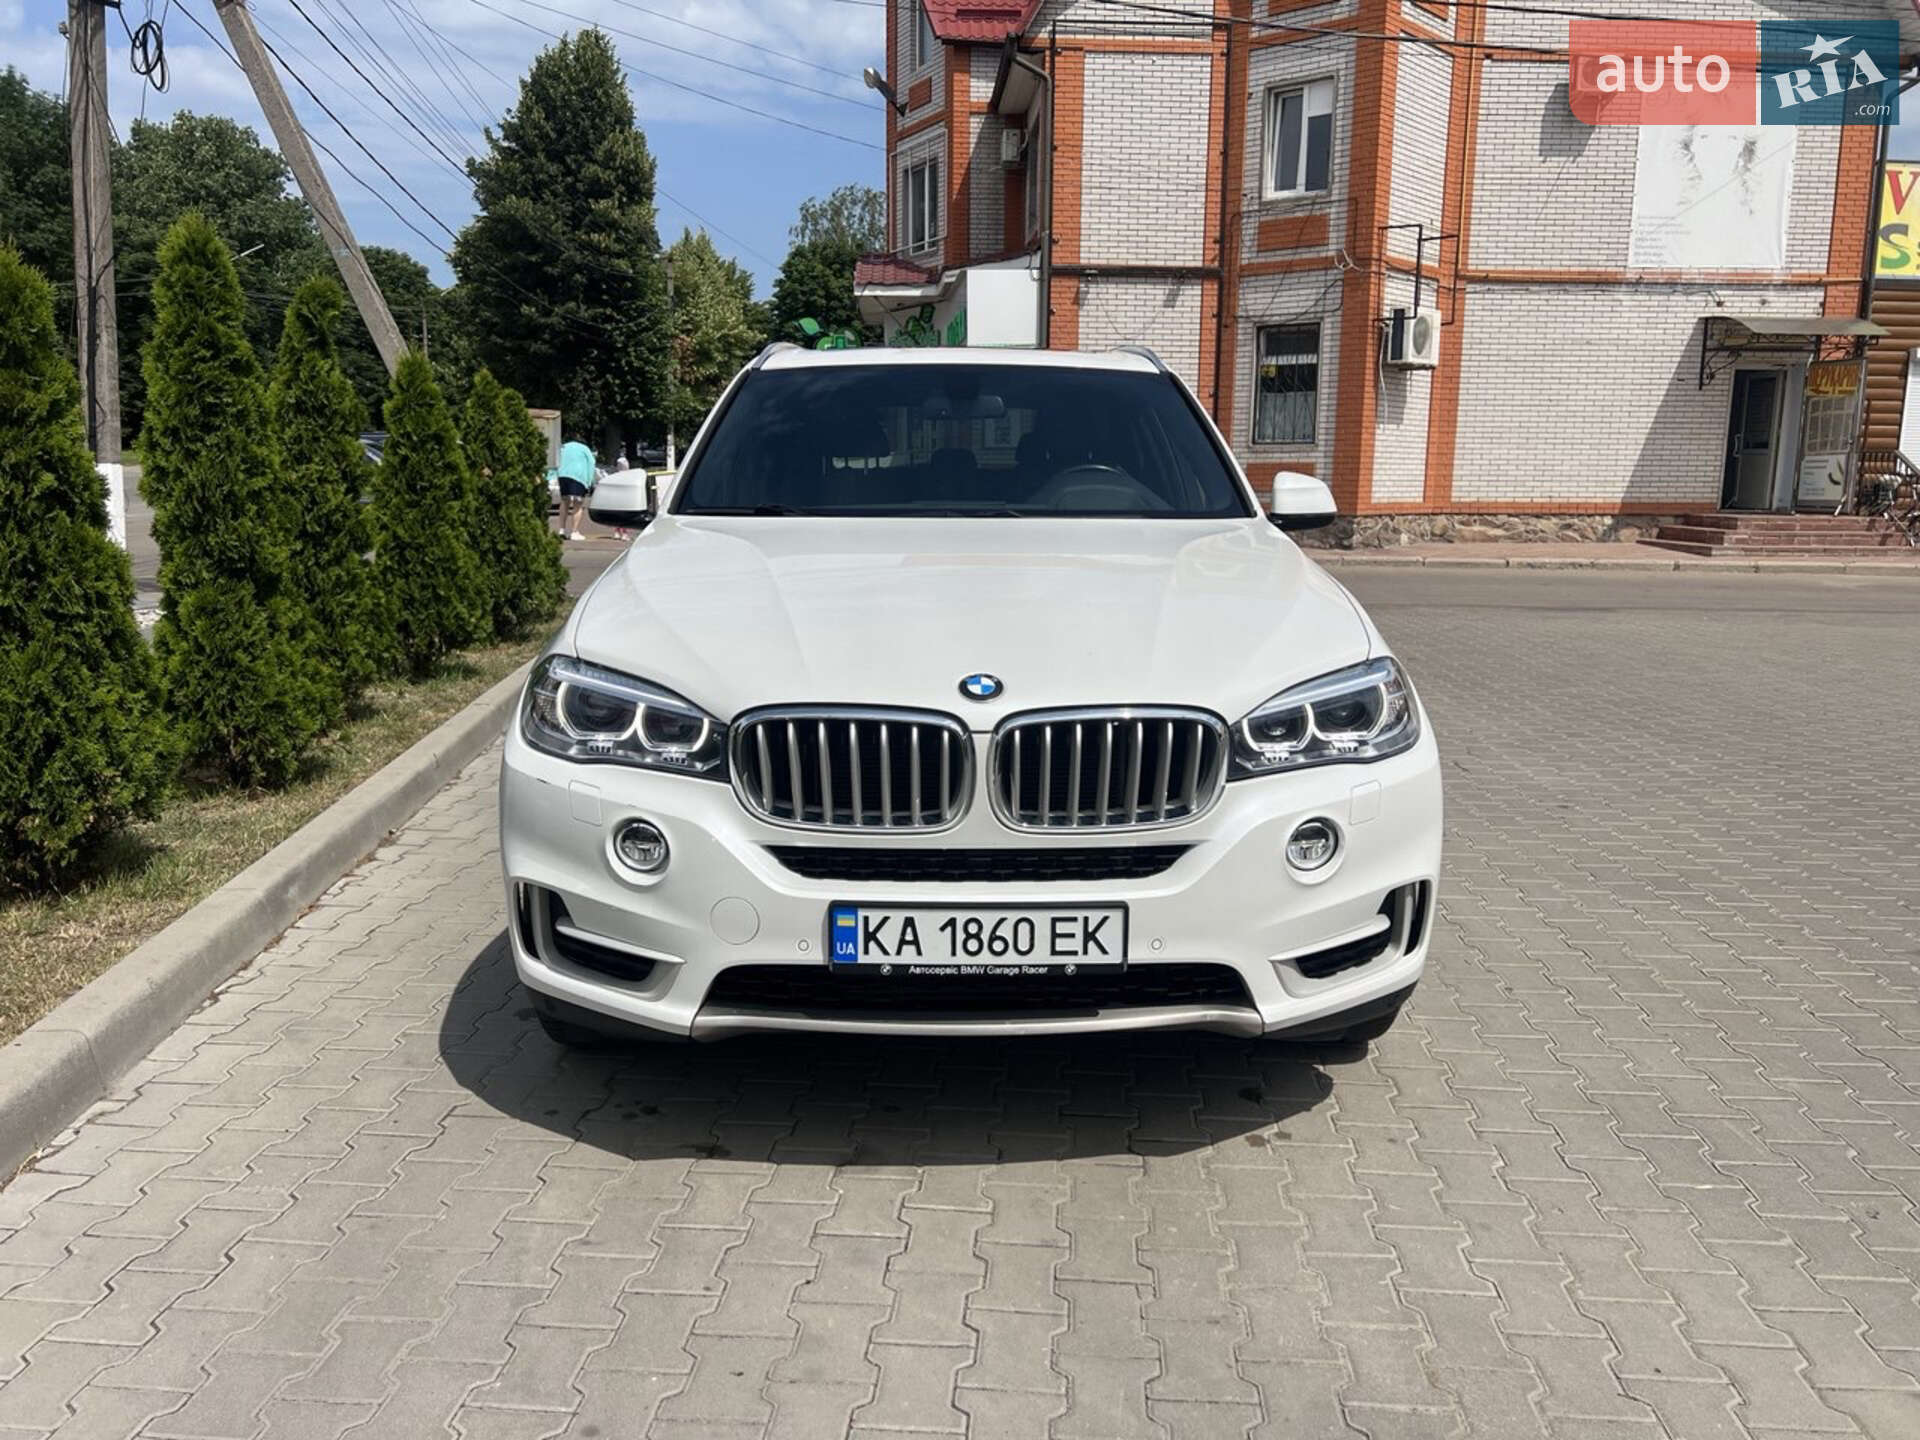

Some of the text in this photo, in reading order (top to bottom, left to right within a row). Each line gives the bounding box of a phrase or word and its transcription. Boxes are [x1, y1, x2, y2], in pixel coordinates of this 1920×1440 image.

[1880, 223, 1920, 269] S
[836, 942, 856, 955] UA
[863, 915, 1110, 957] KA 1860 EK
[960, 965, 985, 974] BMW
[986, 965, 1020, 976] Garage
[1021, 965, 1048, 974] Racer
